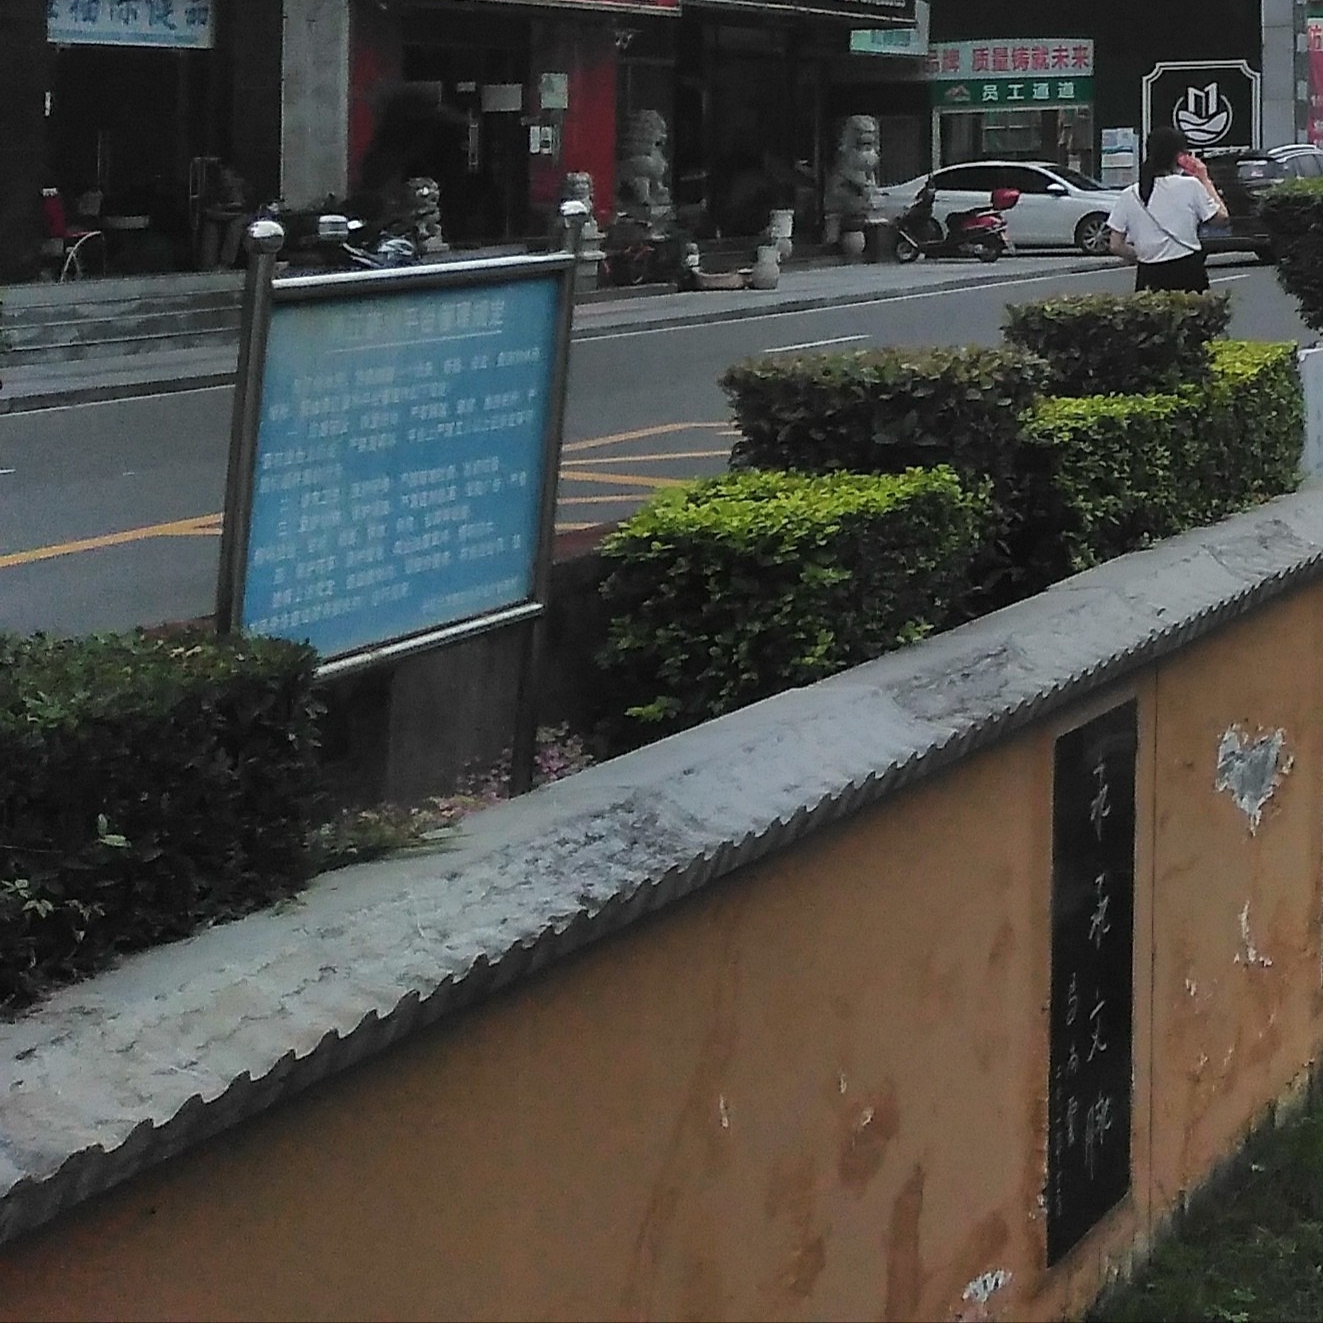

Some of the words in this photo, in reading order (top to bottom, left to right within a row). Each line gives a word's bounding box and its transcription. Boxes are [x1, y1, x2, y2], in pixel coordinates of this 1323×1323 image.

[972, 45, 1089, 72] 质量铸就未来
[981, 82, 1076, 102] 员工通道
